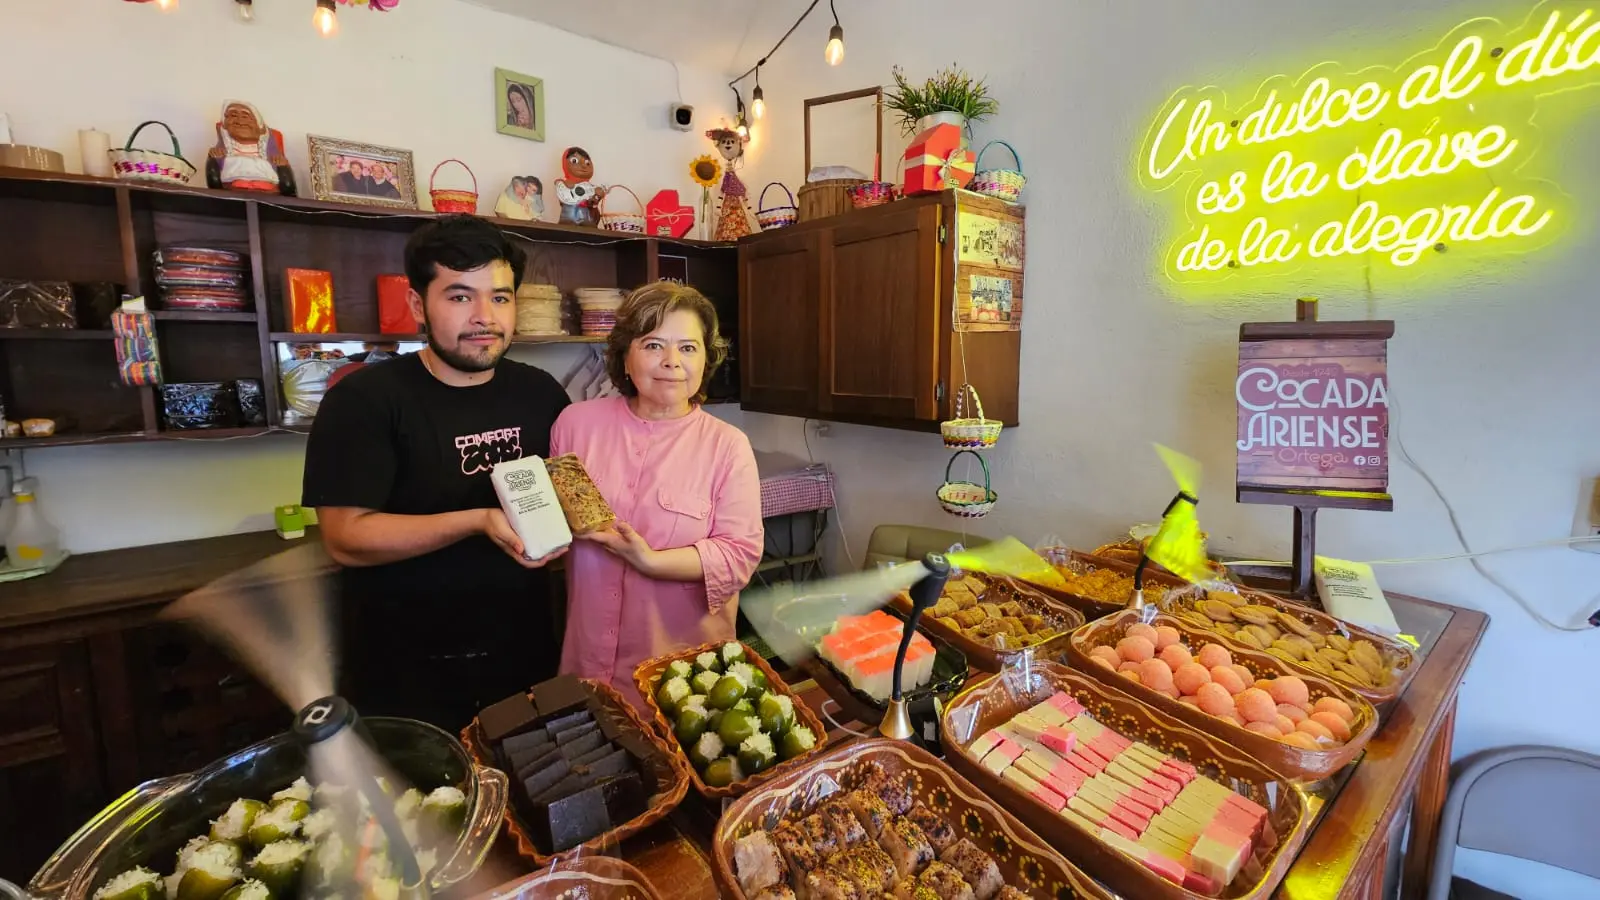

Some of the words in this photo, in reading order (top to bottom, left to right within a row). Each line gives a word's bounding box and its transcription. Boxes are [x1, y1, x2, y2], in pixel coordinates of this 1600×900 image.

[1148, 98, 1233, 180] Un
[1237, 77, 1391, 146] dulce
[1398, 35, 1486, 110] al
[1196, 171, 1246, 215] es
[1260, 150, 1329, 204] la
[1176, 223, 1234, 272] de
[1237, 216, 1302, 267] la
[1236, 367, 1388, 411] COCADA
[455, 427, 521, 449] COMFORT
[1236, 412, 1380, 451] ARIENSE
[1278, 448, 1348, 468] Ortega
